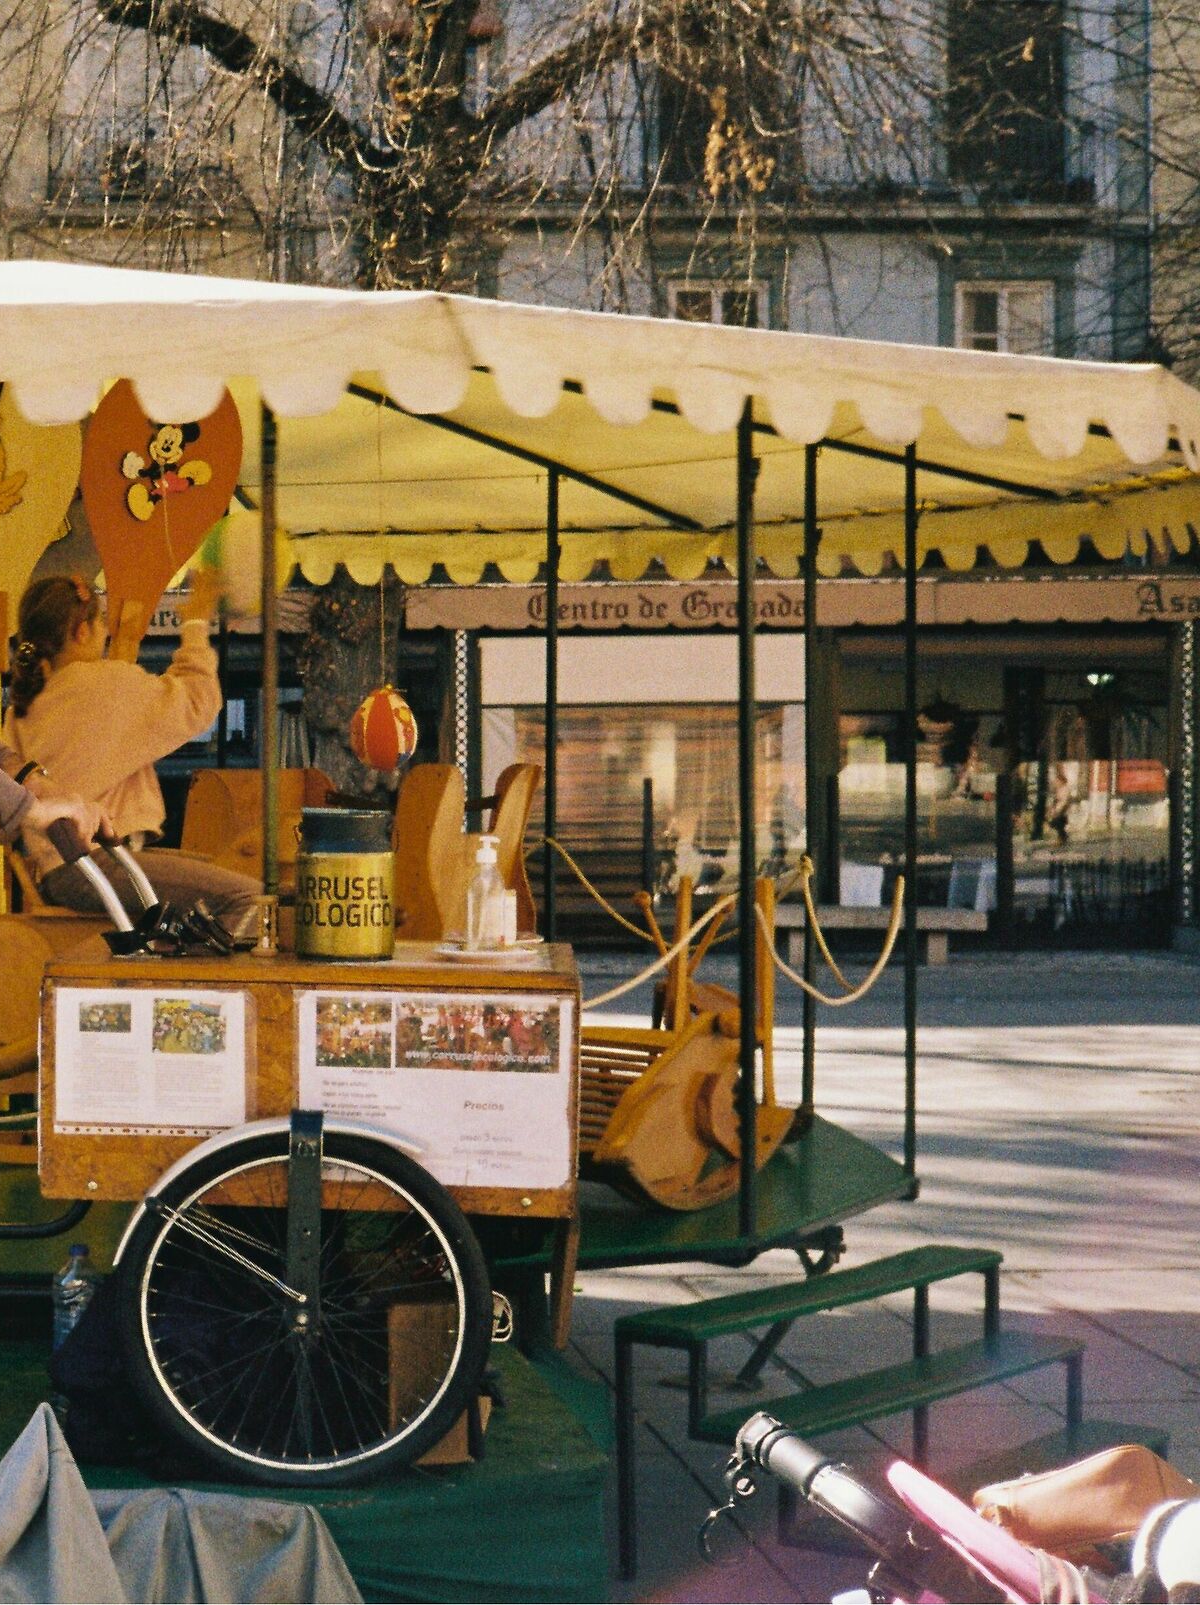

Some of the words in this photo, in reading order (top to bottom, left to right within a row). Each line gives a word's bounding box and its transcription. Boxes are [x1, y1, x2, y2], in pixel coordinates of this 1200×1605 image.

[637, 592, 668, 619] de
[681, 589, 804, 620] Graada
[463, 1100, 505, 1112] Precios
